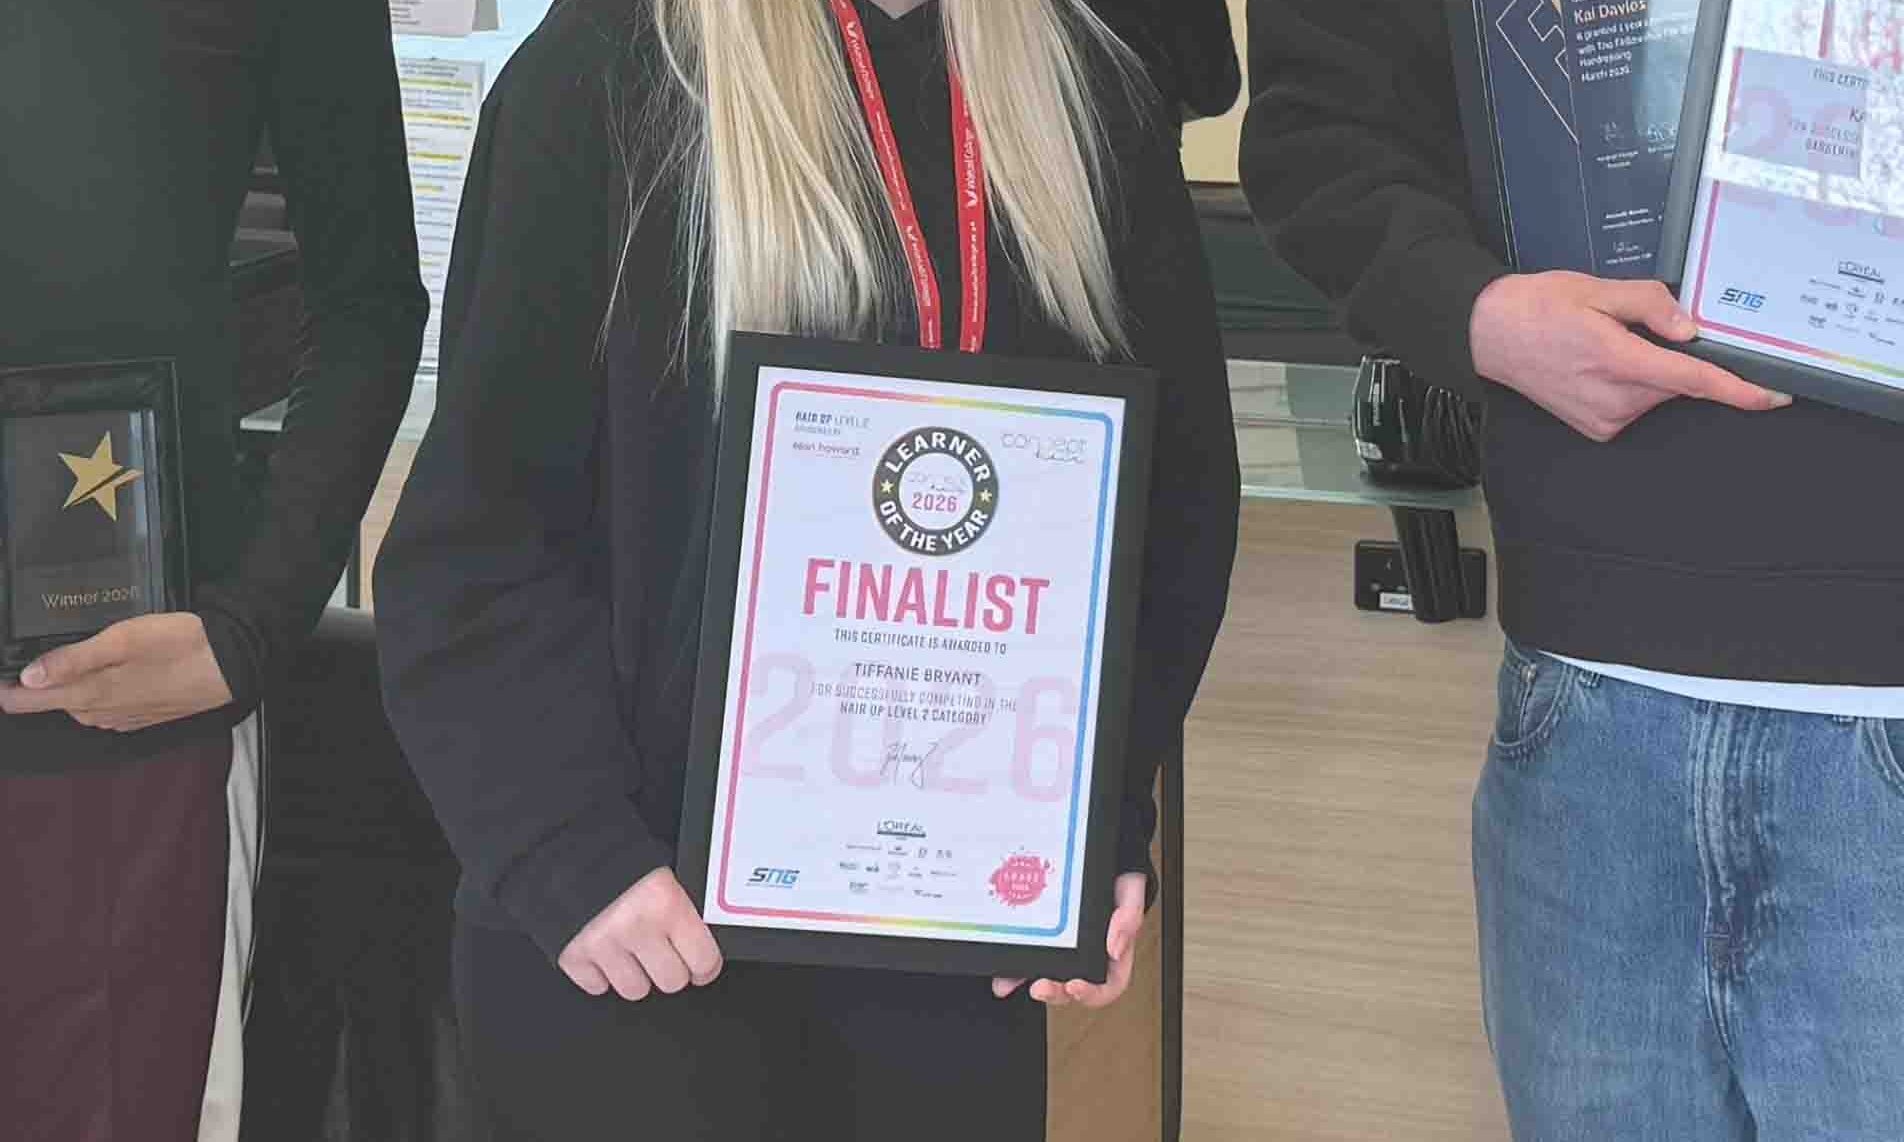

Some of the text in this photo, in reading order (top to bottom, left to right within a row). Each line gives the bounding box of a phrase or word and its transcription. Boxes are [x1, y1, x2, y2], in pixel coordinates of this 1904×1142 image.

[884, 431, 992, 484] LEARNER
[911, 491, 958, 514] 2026
[878, 499, 990, 553] OF THE YEAR
[802, 557, 1051, 635] FINALIST
[833, 627, 1008, 656] THIS CERTIFICATE IS AWARDED TO
[853, 661, 983, 687] TIFFANIE BRYANT
[839, 701, 867, 717] HAIR
[869, 703, 885, 718] UP
[887, 704, 920, 721] LEVEL
[931, 710, 988, 727] CATEGORY
